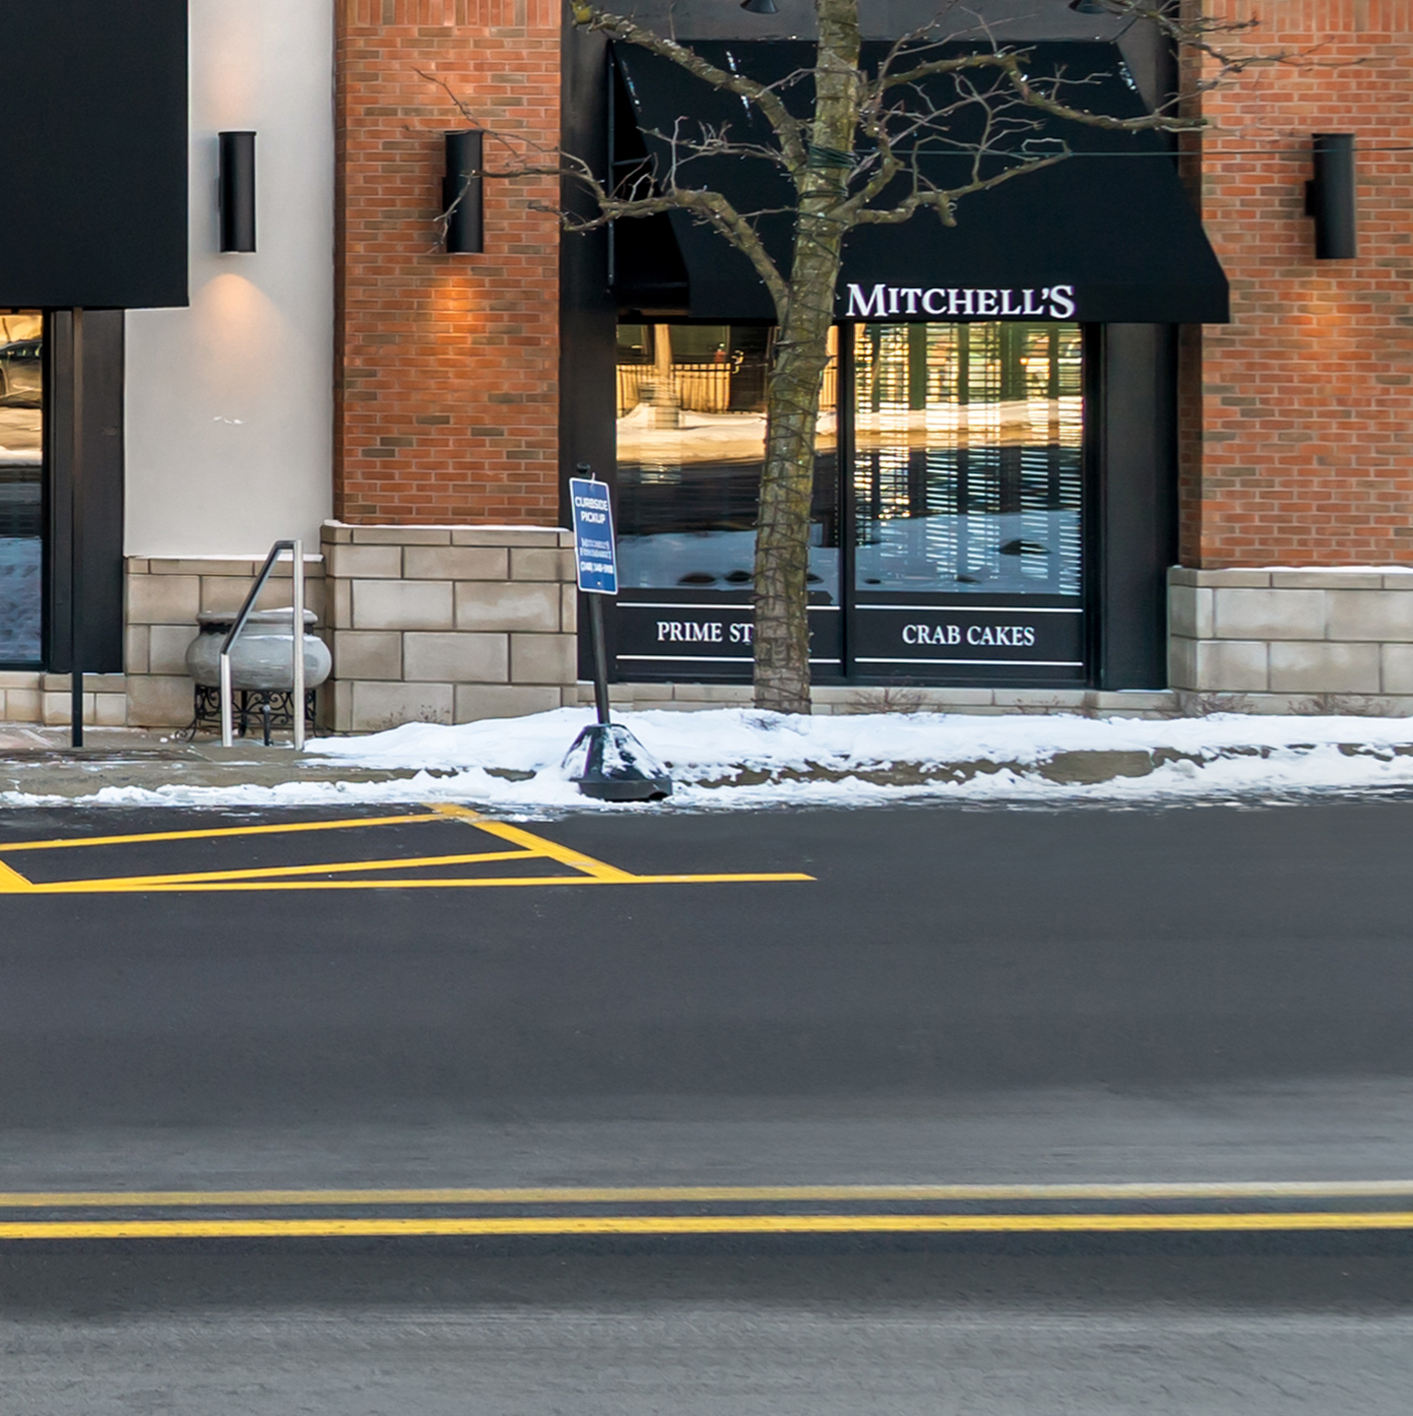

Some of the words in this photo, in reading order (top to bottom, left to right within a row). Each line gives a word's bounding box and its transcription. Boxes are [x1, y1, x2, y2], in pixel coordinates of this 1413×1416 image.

[845, 283, 1075, 319] MITCHELL'S
[575, 496, 608, 511] CURBSIDE
[580, 510, 606, 524] PICKUP
[656, 621, 723, 643] PRIME
[902, 624, 961, 645] CRAB
[966, 625, 1035, 647] CAKES
